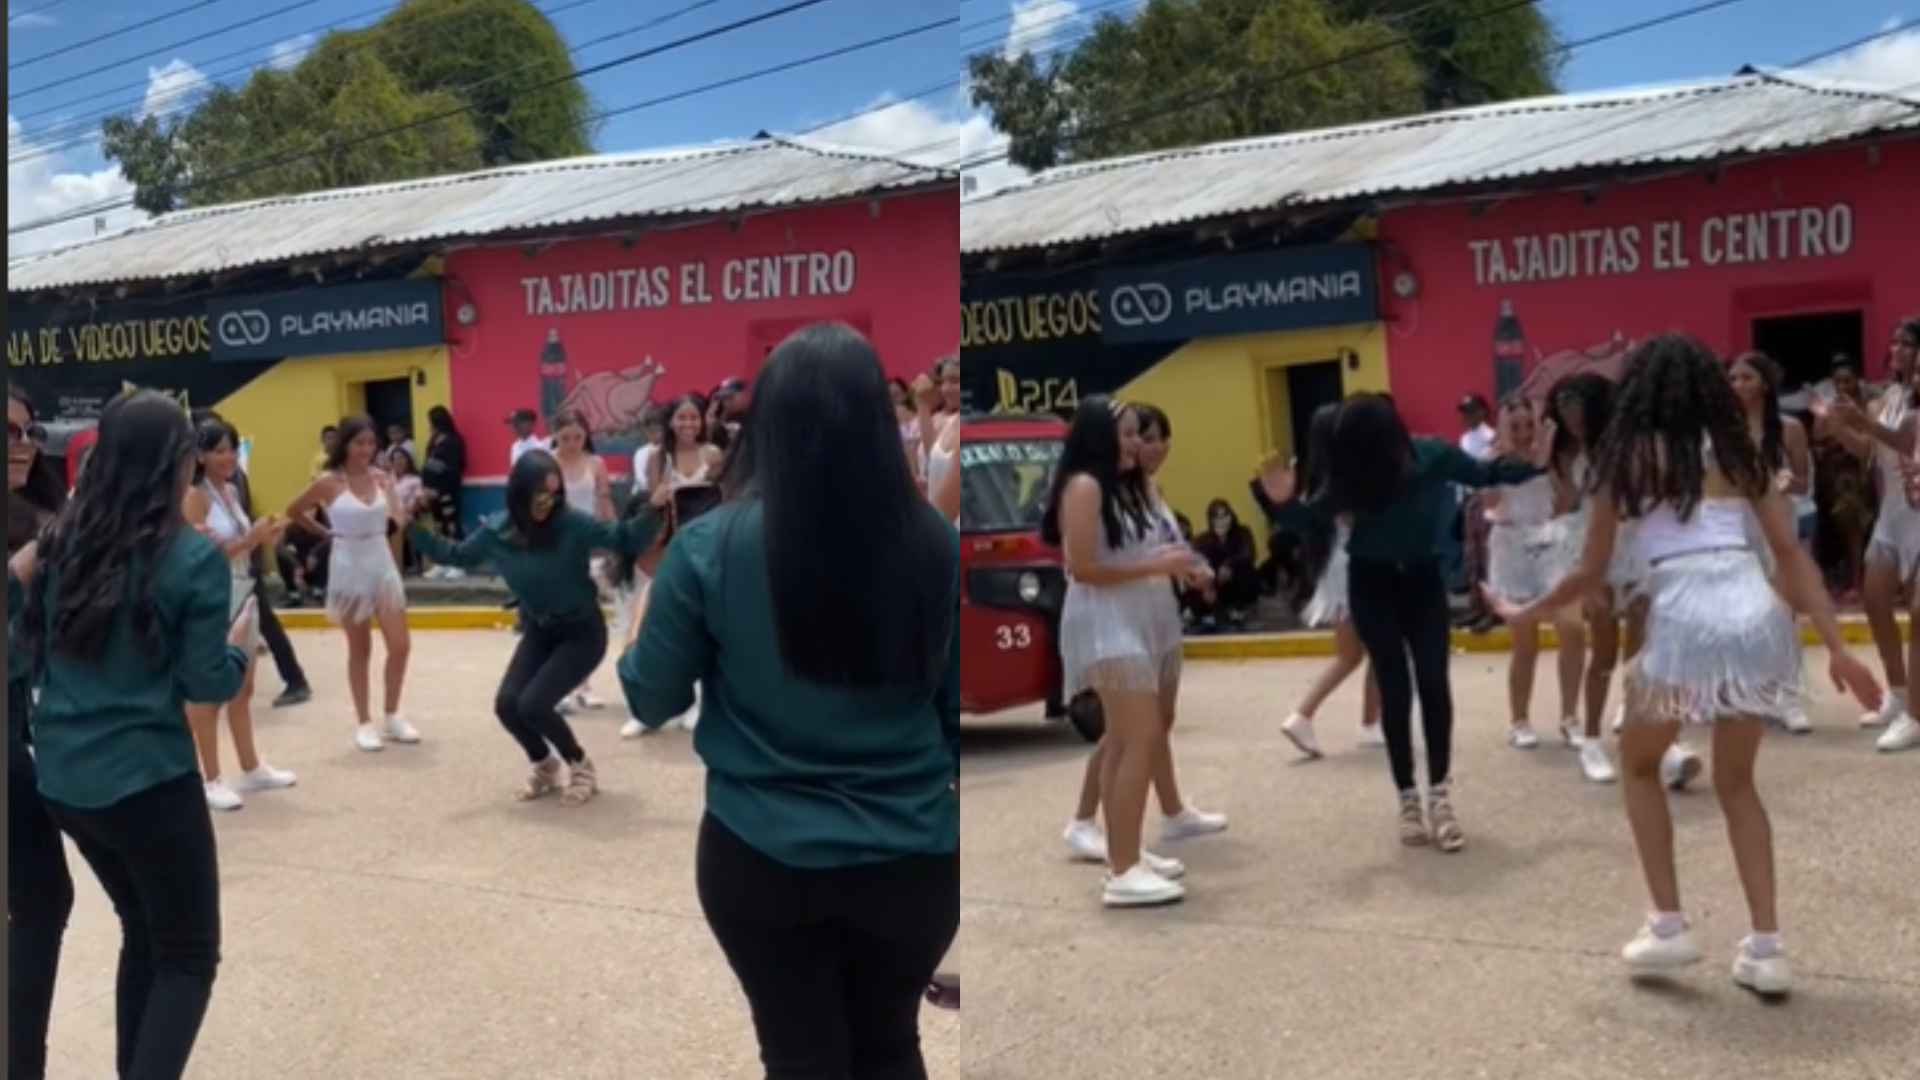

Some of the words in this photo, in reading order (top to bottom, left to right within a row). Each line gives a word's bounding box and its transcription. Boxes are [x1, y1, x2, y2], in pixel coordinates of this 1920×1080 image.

[1468, 225, 1640, 284] TAJADITAS
[1653, 221, 1690, 269] EL
[1702, 204, 1852, 265] CENTRO
[521, 266, 669, 315] TAJADITAS
[681, 263, 711, 304] EL
[722, 250, 855, 300] CENTRO
[1185, 270, 1361, 315] PLAYMANIA
[40, 328, 64, 364] DE
[68, 314, 211, 361] VIDEOJUEGOS
[281, 301, 429, 336] PLAYMANIA
[996, 623, 1032, 649] 33
